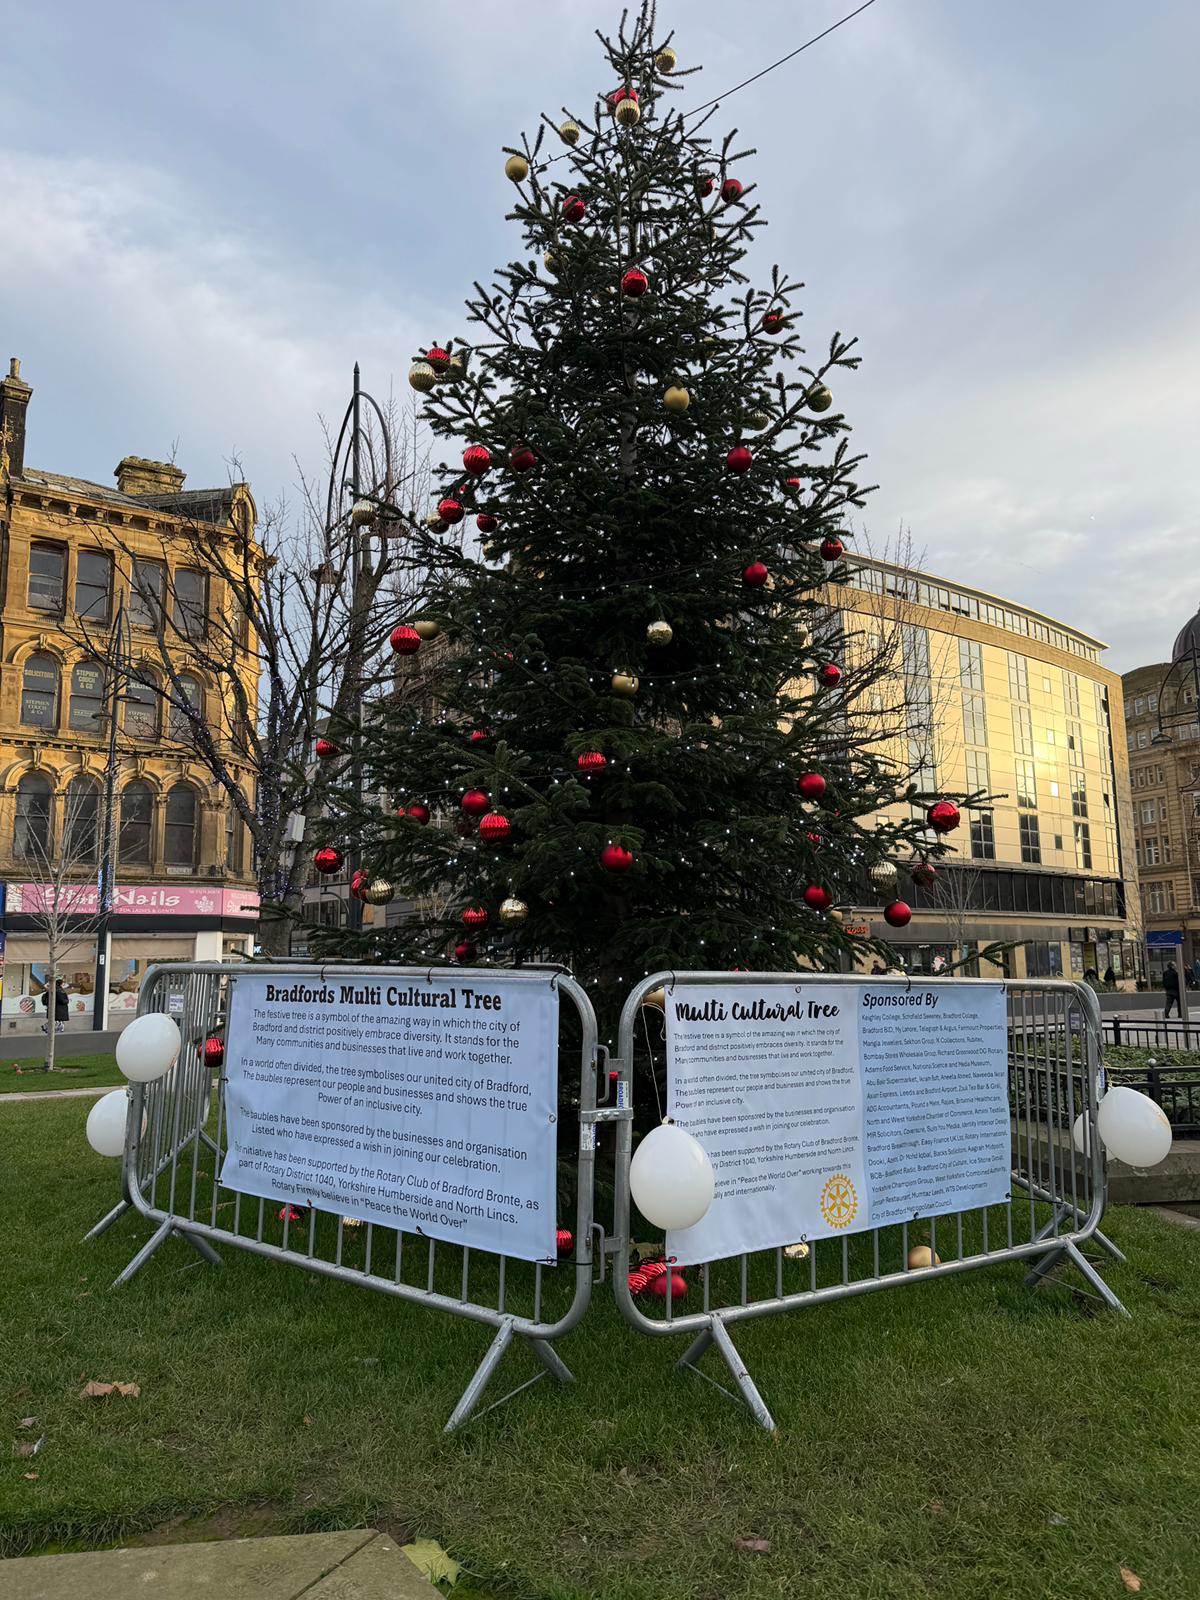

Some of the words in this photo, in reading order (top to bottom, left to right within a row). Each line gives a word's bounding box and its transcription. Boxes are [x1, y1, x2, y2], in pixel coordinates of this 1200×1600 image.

[76, 670, 99, 678] STEPHEN
[41, 887, 98, 905] Star
[112, 888, 180, 906] Nails
[266, 985, 334, 1003] Bradfords
[340, 986, 381, 1005] Multi
[387, 987, 456, 1008] Cultural
[462, 989, 501, 1010] Tree
[863, 993, 923, 1009] Sponsored
[925, 993, 939, 1008] By
[254, 1009, 265, 1018] The
[267, 1010, 290, 1019] festive
[292, 1012, 306, 1020] tree
[308, 1011, 313, 1020] is
[322, 1013, 349, 1023] symbol
[351, 1014, 359, 1022] of
[362, 1014, 374, 1023] the
[376, 1016, 411, 1028] amazing
[413, 1018, 431, 1028] way
[433, 1017, 440, 1026] in
[443, 1018, 470, 1028] which
[473, 1019, 487, 1030] the
[489, 1021, 507, 1033] city
[510, 1022, 520, 1031] of
[675, 1000, 728, 1021] Multi
[732, 999, 804, 1022] Cultural
[808, 1001, 840, 1018] Tree
[253, 1022, 282, 1032] Bradford
[284, 1025, 297, 1033] and
[299, 1025, 324, 1034] district
[326, 1027, 364, 1039] positively
[365, 1029, 401, 1040] embrace
[404, 1031, 442, 1044] diversity.
[446, 1033, 451, 1043] It
[454, 1035, 484, 1046] stands
[486, 1036, 500, 1046] for
[503, 1037, 519, 1048] the
[257, 1036, 275, 1047] Many
[277, 1039, 323, 1048] communities
[325, 1041, 340, 1050] and
[342, 1041, 386, 1054] businesses
[389, 1045, 406, 1055] that
[409, 1046, 423, 1056] live
[426, 1048, 442, 1058] and
[445, 1050, 466, 1060] work
[469, 1052, 511, 1064] together.
[241, 1057, 247, 1066] In
[255, 1060, 274, 1068] world
[275, 1060, 292, 1070] often
[294, 1062, 324, 1074] divided,
[326, 1065, 339, 1074] the
[341, 1067, 356, 1076] tree
[358, 1069, 404, 1081] symbolises
[407, 1074, 422, 1082] our
[424, 1075, 453, 1086] united
[455, 1077, 472, 1090] city
[474, 1079, 484, 1089] of
[487, 1080, 531, 1095] Bradford,
[243, 1068, 254, 1080] The
[256, 1072, 282, 1083] baubles
[284, 1077, 320, 1087] represent
[338, 1082, 365, 1093] people
[367, 1085, 381, 1094] and
[384, 1086, 433, 1100] businesses
[436, 1092, 454, 1102] and
[457, 1093, 487, 1106] shows
[490, 1097, 505, 1108] the
[508, 1100, 527, 1111] true
[319, 1092, 342, 1104] Power
[344, 1096, 352, 1105] of
[366, 1098, 402, 1112] inclusive
[404, 1103, 422, 1116] city.
[737, 1113, 766, 1122] sponsored
[766, 1112, 774, 1120] by
[785, 1109, 812, 1117] businesses
[281, 1114, 299, 1124] have
[302, 1116, 319, 1127] been
[322, 1121, 364, 1134] sponsored
[366, 1126, 375, 1138] by
[377, 1128, 390, 1138] the
[393, 1130, 443, 1146] businesses
[446, 1140, 463, 1149] and
[466, 1143, 526, 1160] organisation
[718, 1126, 748, 1136] expressed
[252, 1124, 274, 1135] Listed
[277, 1128, 293, 1138] who
[295, 1130, 312, 1141] have
[314, 1135, 354, 1148] expressed
[363, 1142, 381, 1152] wish
[384, 1144, 391, 1154] in
[393, 1145, 423, 1162] joining
[425, 1153, 441, 1162] our
[443, 1155, 500, 1173] celebration.
[757, 1155, 784, 1163] Yorkshire
[785, 1152, 816, 1160] Humberside
[720, 1160, 741, 1168] District
[239, 1160, 253, 1168] part
[263, 1162, 285, 1177] Rotary
[286, 1167, 313, 1182] District
[315, 1174, 335, 1188] 1040,
[339, 1178, 375, 1195] Yorkshire
[378, 1186, 433, 1206] Humberside
[435, 1200, 453, 1210] and
[456, 1201, 484, 1216] North
[487, 1207, 517, 1223] Lincs.
[274, 1151, 287, 1161] has
[288, 1153, 306, 1165] been
[308, 1159, 348, 1173] supported
[349, 1165, 359, 1177] by
[361, 1167, 374, 1178] the
[377, 1169, 405, 1186] Rotary
[407, 1175, 428, 1188] Club
[431, 1180, 440, 1190] of
[442, 1181, 484, 1199] Bradford
[487, 1190, 522, 1208] Bronte,
[526, 1200, 539, 1210] as
[272, 1179, 295, 1193] Rotary
[321, 1190, 349, 1204] believe
[351, 1196, 359, 1206] in
[360, 1198, 391, 1213] "Peace
[393, 1205, 407, 1216] the
[409, 1208, 438, 1222] World
[440, 1214, 467, 1228] Over"
